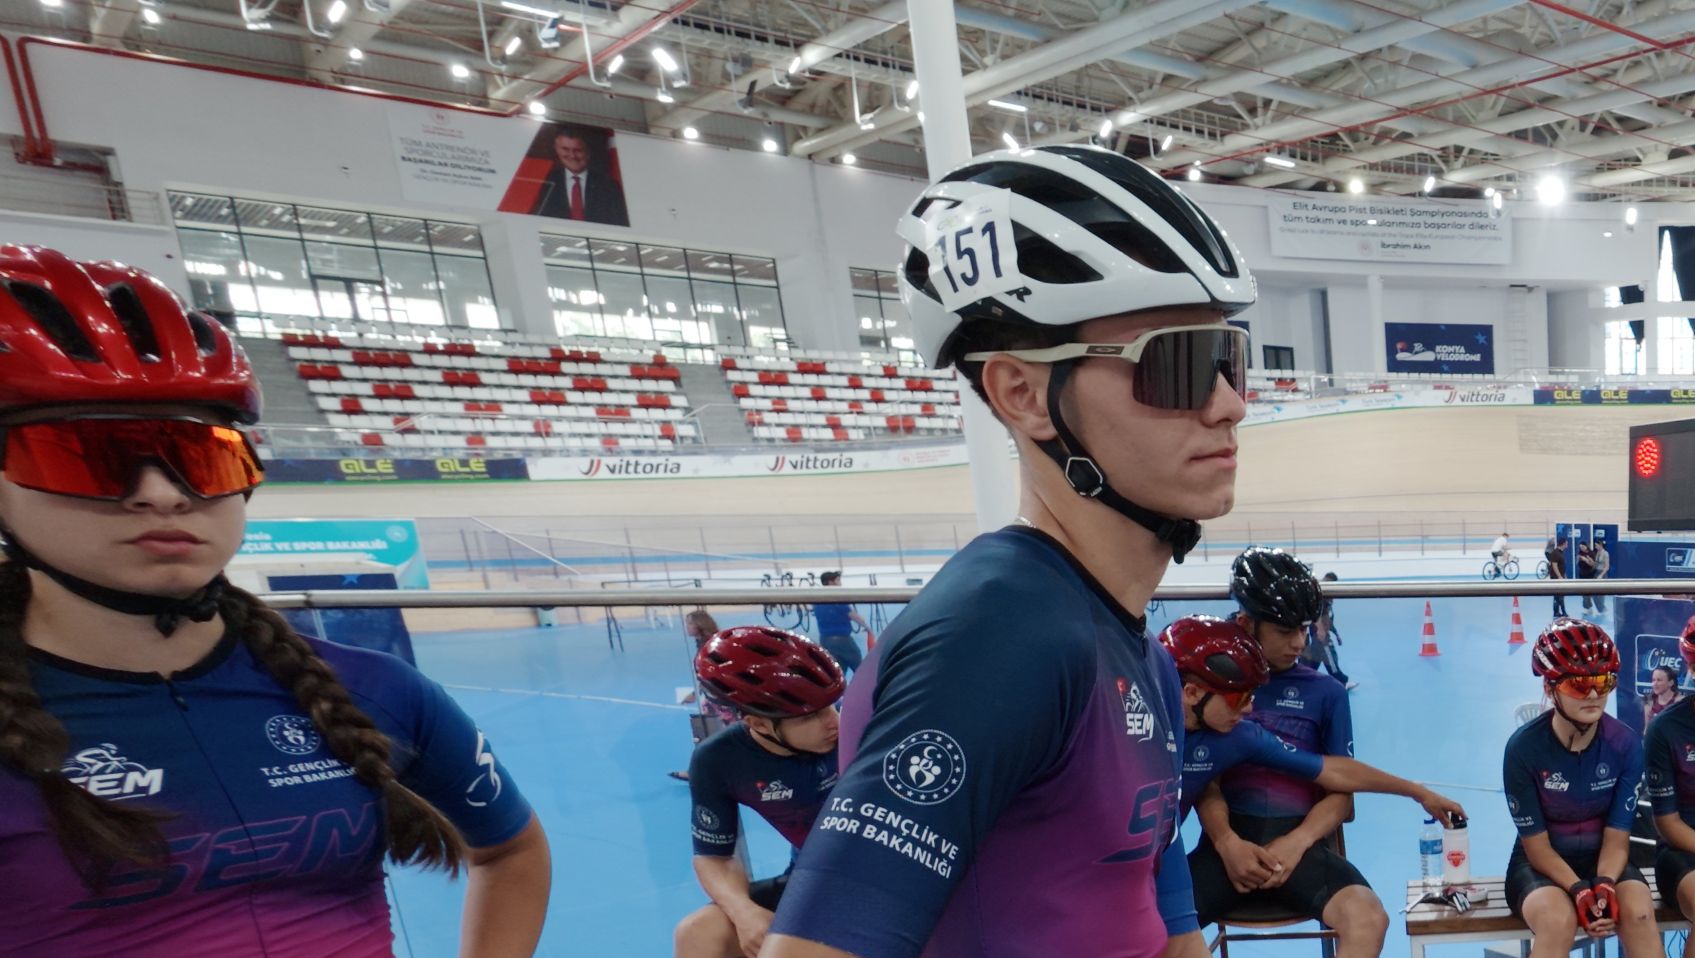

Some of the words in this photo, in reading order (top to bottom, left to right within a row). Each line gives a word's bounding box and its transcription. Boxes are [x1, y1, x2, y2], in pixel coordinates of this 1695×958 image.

[1293, 202, 1309, 211] Elit
[1311, 203, 1347, 214] Avrupa
[936, 221, 1003, 293] 151
[1435, 345, 1465, 353] KONYA
[1436, 353, 1481, 362] VELODROME
[1459, 389, 1505, 403] vittoria
[605, 457, 682, 475] vittoria
[789, 453, 853, 470] vittoria
[1659, 657, 1682, 668] UEC
[1126, 713, 1154, 742] SEM
[260, 767, 286, 777] T.C.
[287, 758, 341, 775] GENÇLİK
[268, 775, 303, 788] SPOR
[304, 767, 358, 784] BAKANLI
[761, 789, 793, 801] SEM
[1543, 781, 1570, 792] SEM
[830, 798, 854, 813] T.C.
[860, 802, 940, 849] GENÇLİK
[940, 838, 959, 860] VE
[820, 816, 860, 834] SPOR
[862, 824, 953, 879] BAKANLIĞI
